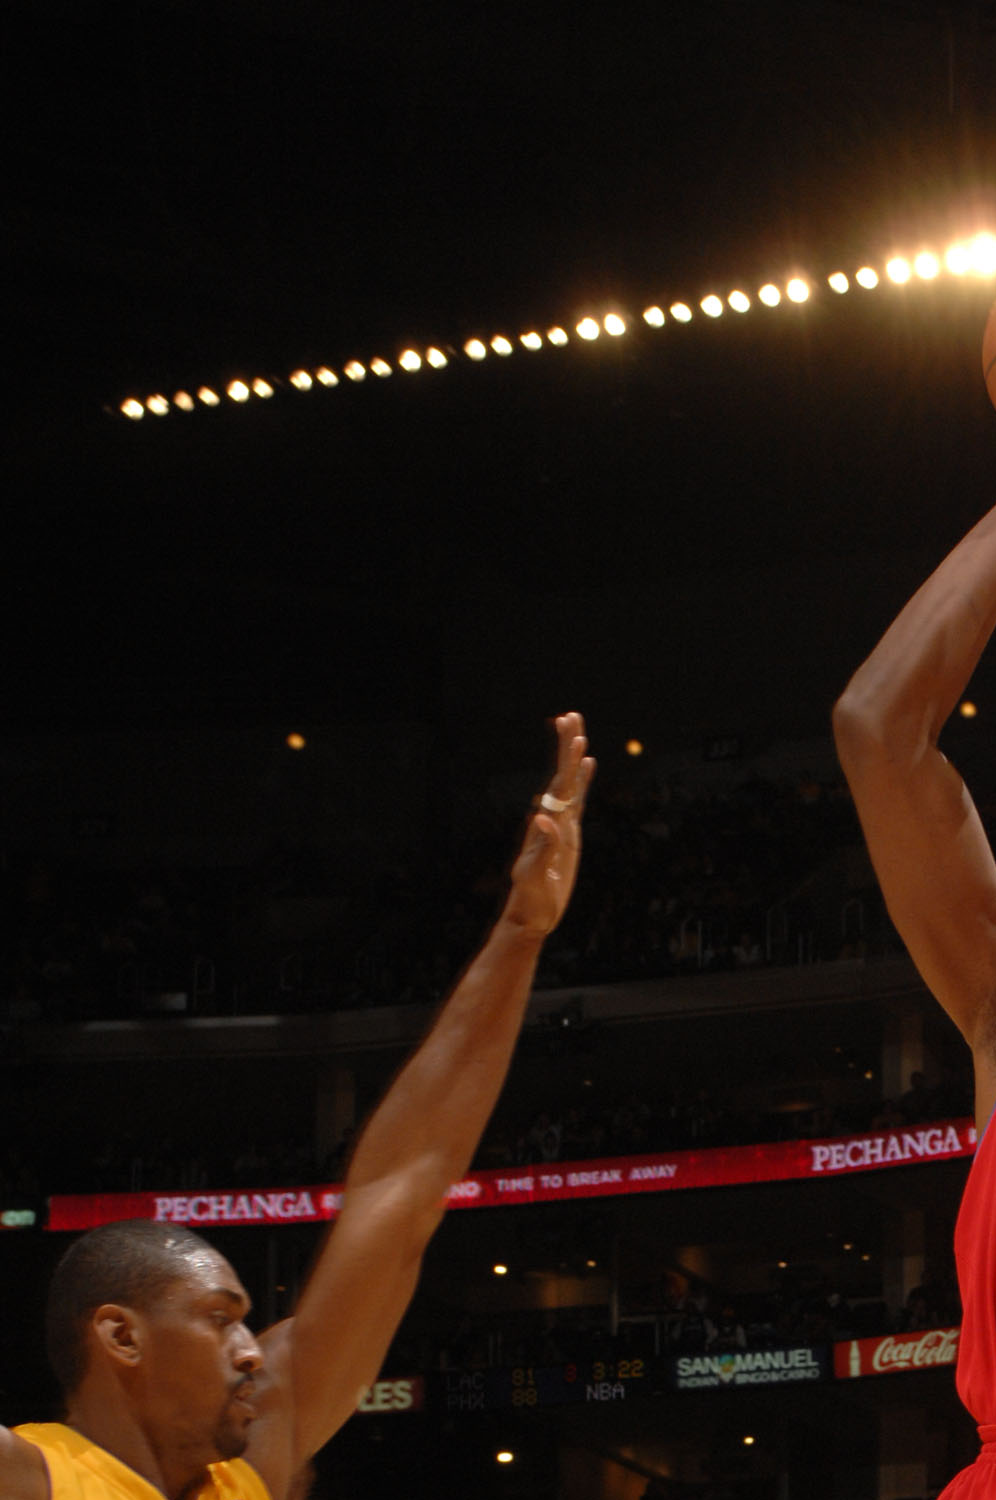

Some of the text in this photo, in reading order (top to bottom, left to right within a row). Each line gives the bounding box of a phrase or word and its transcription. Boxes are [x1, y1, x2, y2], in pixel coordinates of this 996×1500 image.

[811, 1127, 962, 1172] PECHANGA
[497, 1164, 677, 1193] TIME TO BREAK AWAY
[155, 1193, 315, 1222] PECHANGA
[677, 1350, 819, 1376] SAN MANUEL
[586, 1382, 626, 1401] NBA
